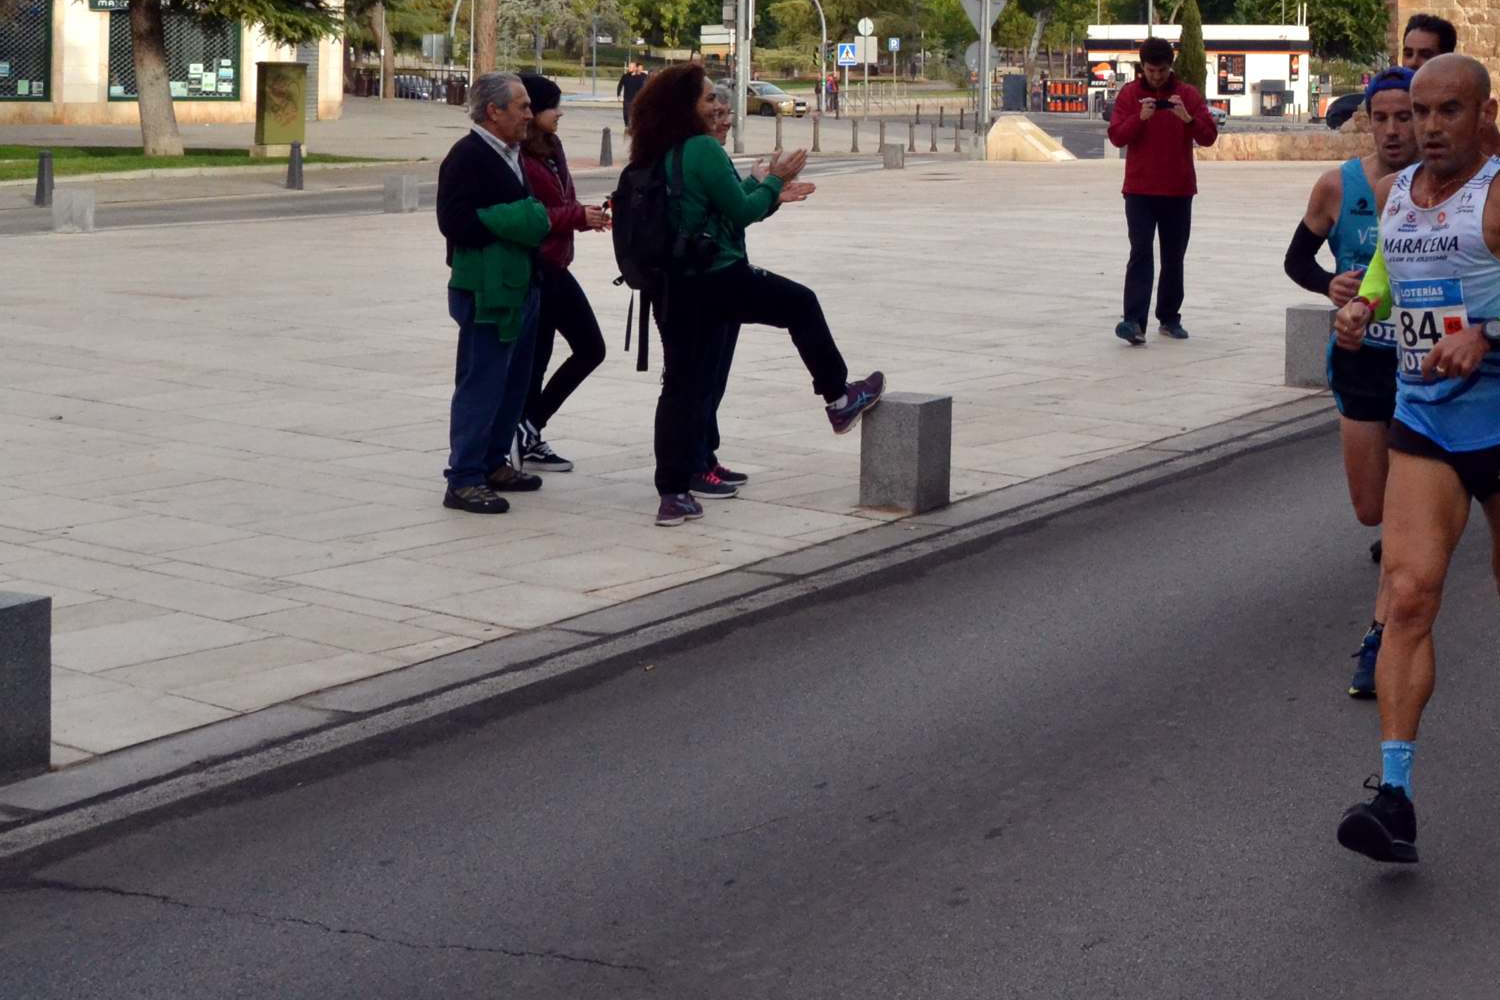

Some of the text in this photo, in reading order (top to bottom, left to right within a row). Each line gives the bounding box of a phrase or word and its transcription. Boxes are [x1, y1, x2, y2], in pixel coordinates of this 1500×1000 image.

[891, 39, 898, 49] P
[1384, 235, 1459, 254] MARACENA
[1400, 311, 1442, 347] 84
